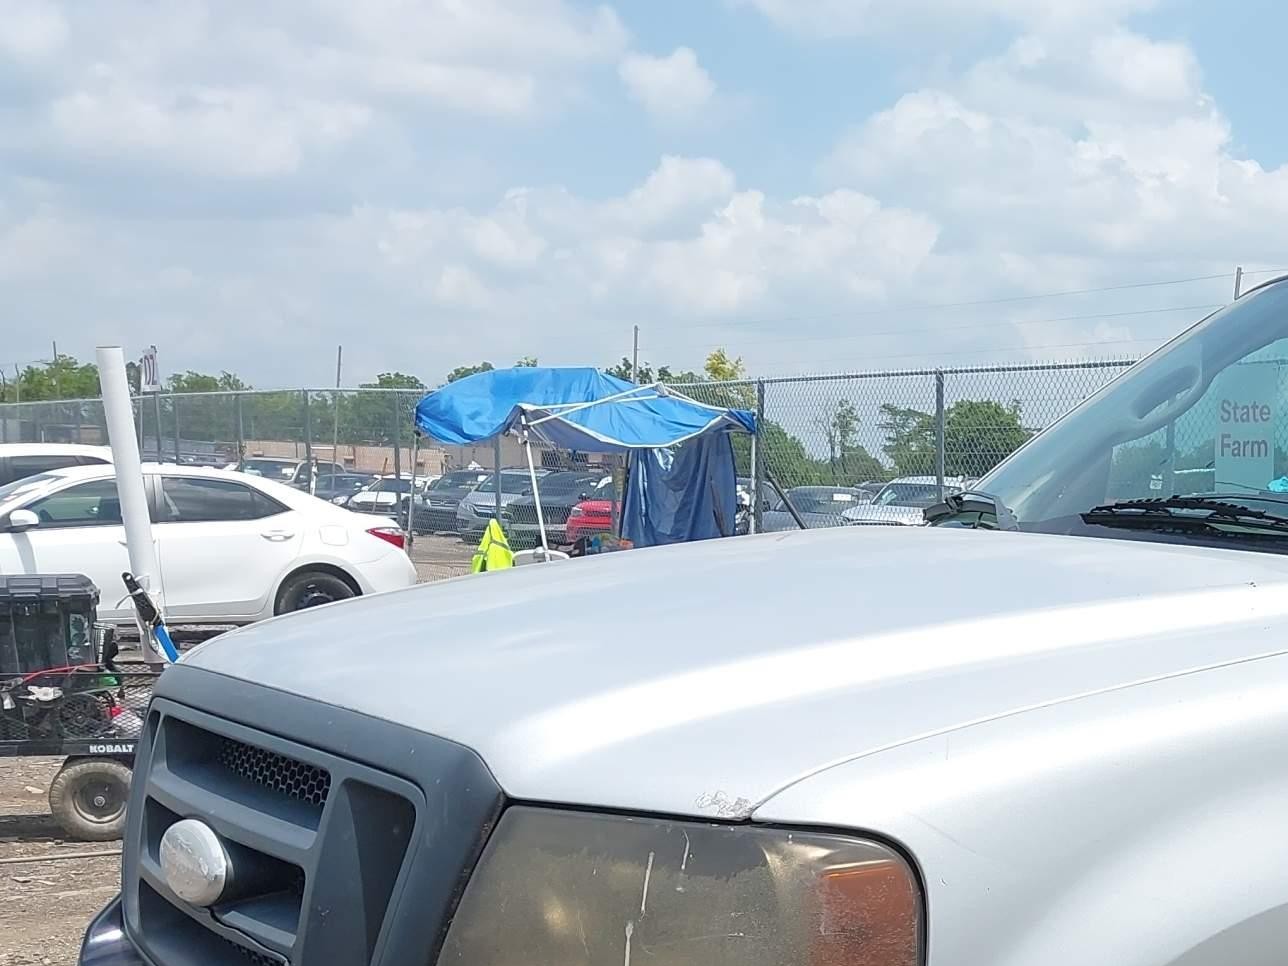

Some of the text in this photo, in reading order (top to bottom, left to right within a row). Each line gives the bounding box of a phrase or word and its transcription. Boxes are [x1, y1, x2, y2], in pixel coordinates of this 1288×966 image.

[1220, 400, 1271, 423] State
[1220, 433, 1268, 457] Farm
[89, 744, 134, 753] KOBALT
